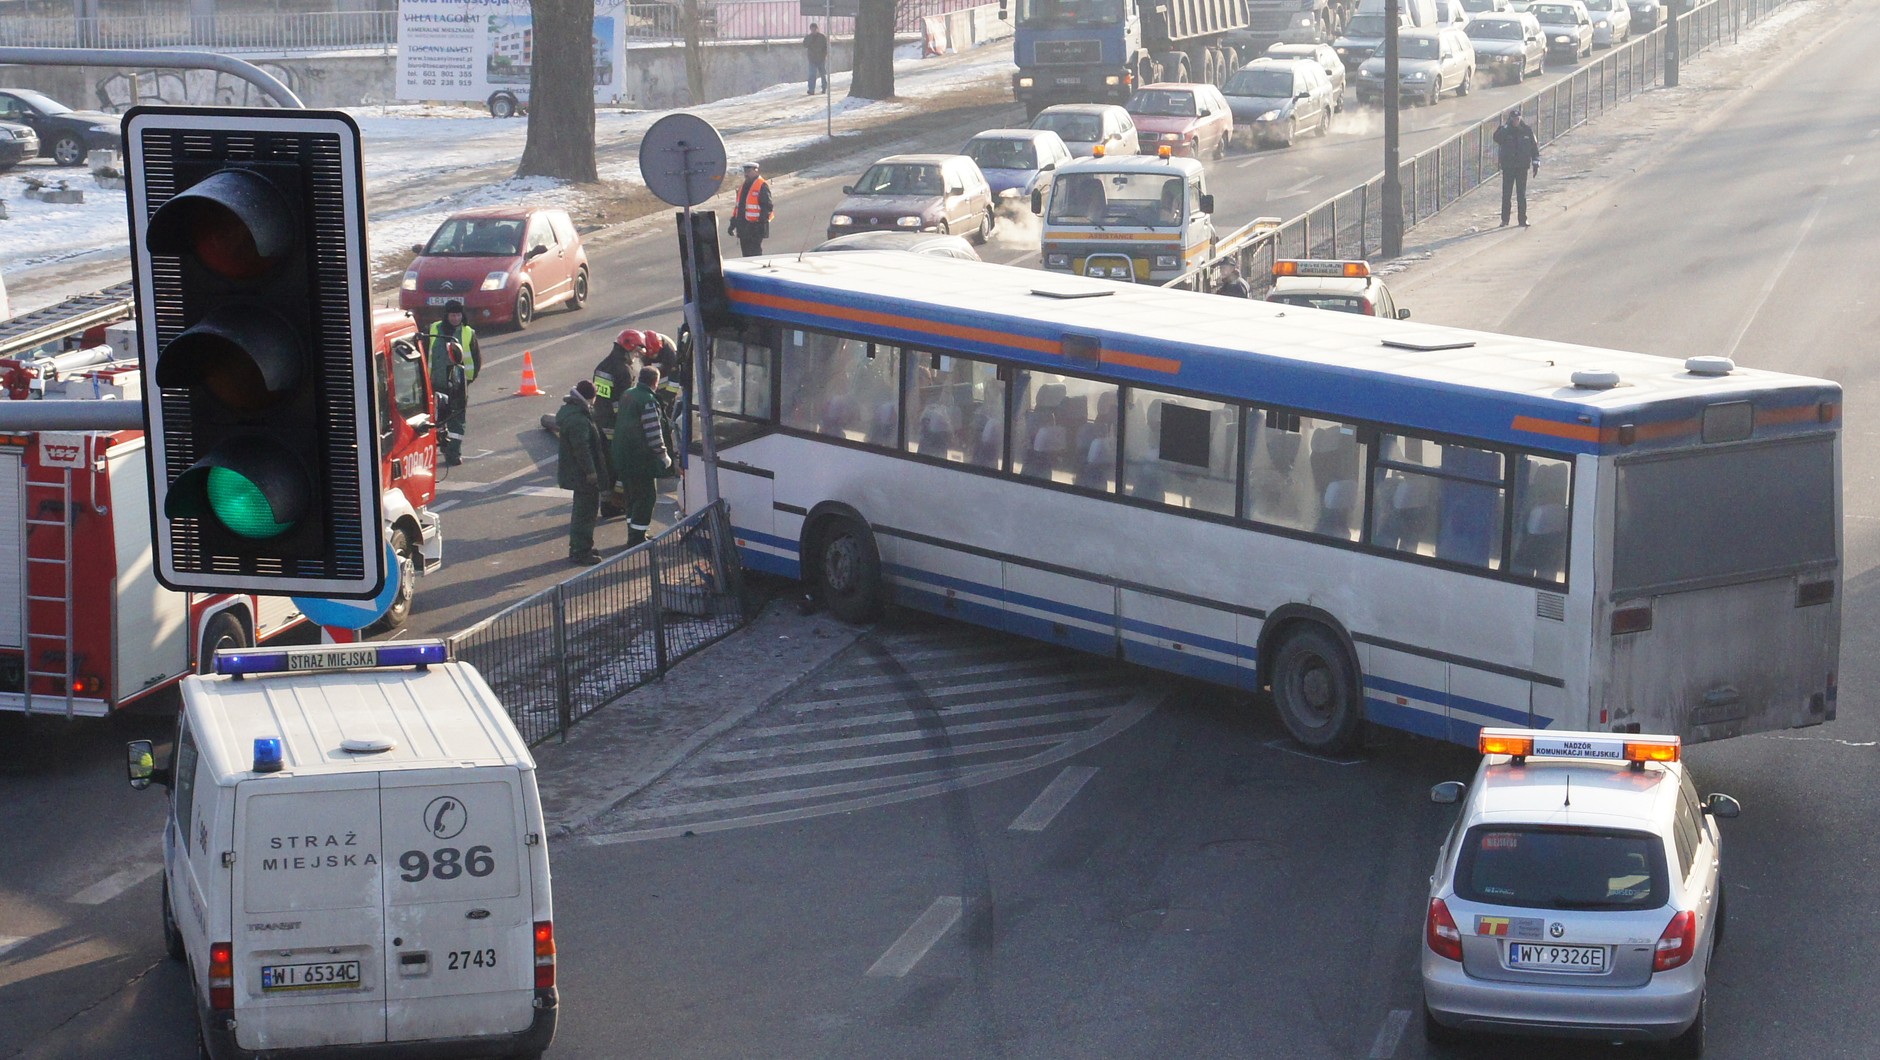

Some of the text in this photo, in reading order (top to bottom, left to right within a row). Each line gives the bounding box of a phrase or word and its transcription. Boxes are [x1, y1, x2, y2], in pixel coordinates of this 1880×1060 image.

[403, 14, 431, 22] VILLA
[327, 651, 373, 667] MIEJSKA
[1536, 748, 1619, 758] KOMUNIKACJI MIEJSKIEJ
[1564, 742, 1591, 750] NADZÓR
[270, 830, 357, 850] STRAŻ
[263, 853, 377, 871] MIEJSKA
[399, 845, 495, 883] 986
[247, 921, 301, 931] TRANSIT
[448, 949, 496, 970] 2743
[1521, 946, 1600, 965] WY 9326E
[273, 967, 294, 984] WI
[304, 964, 356, 982] 6534C
